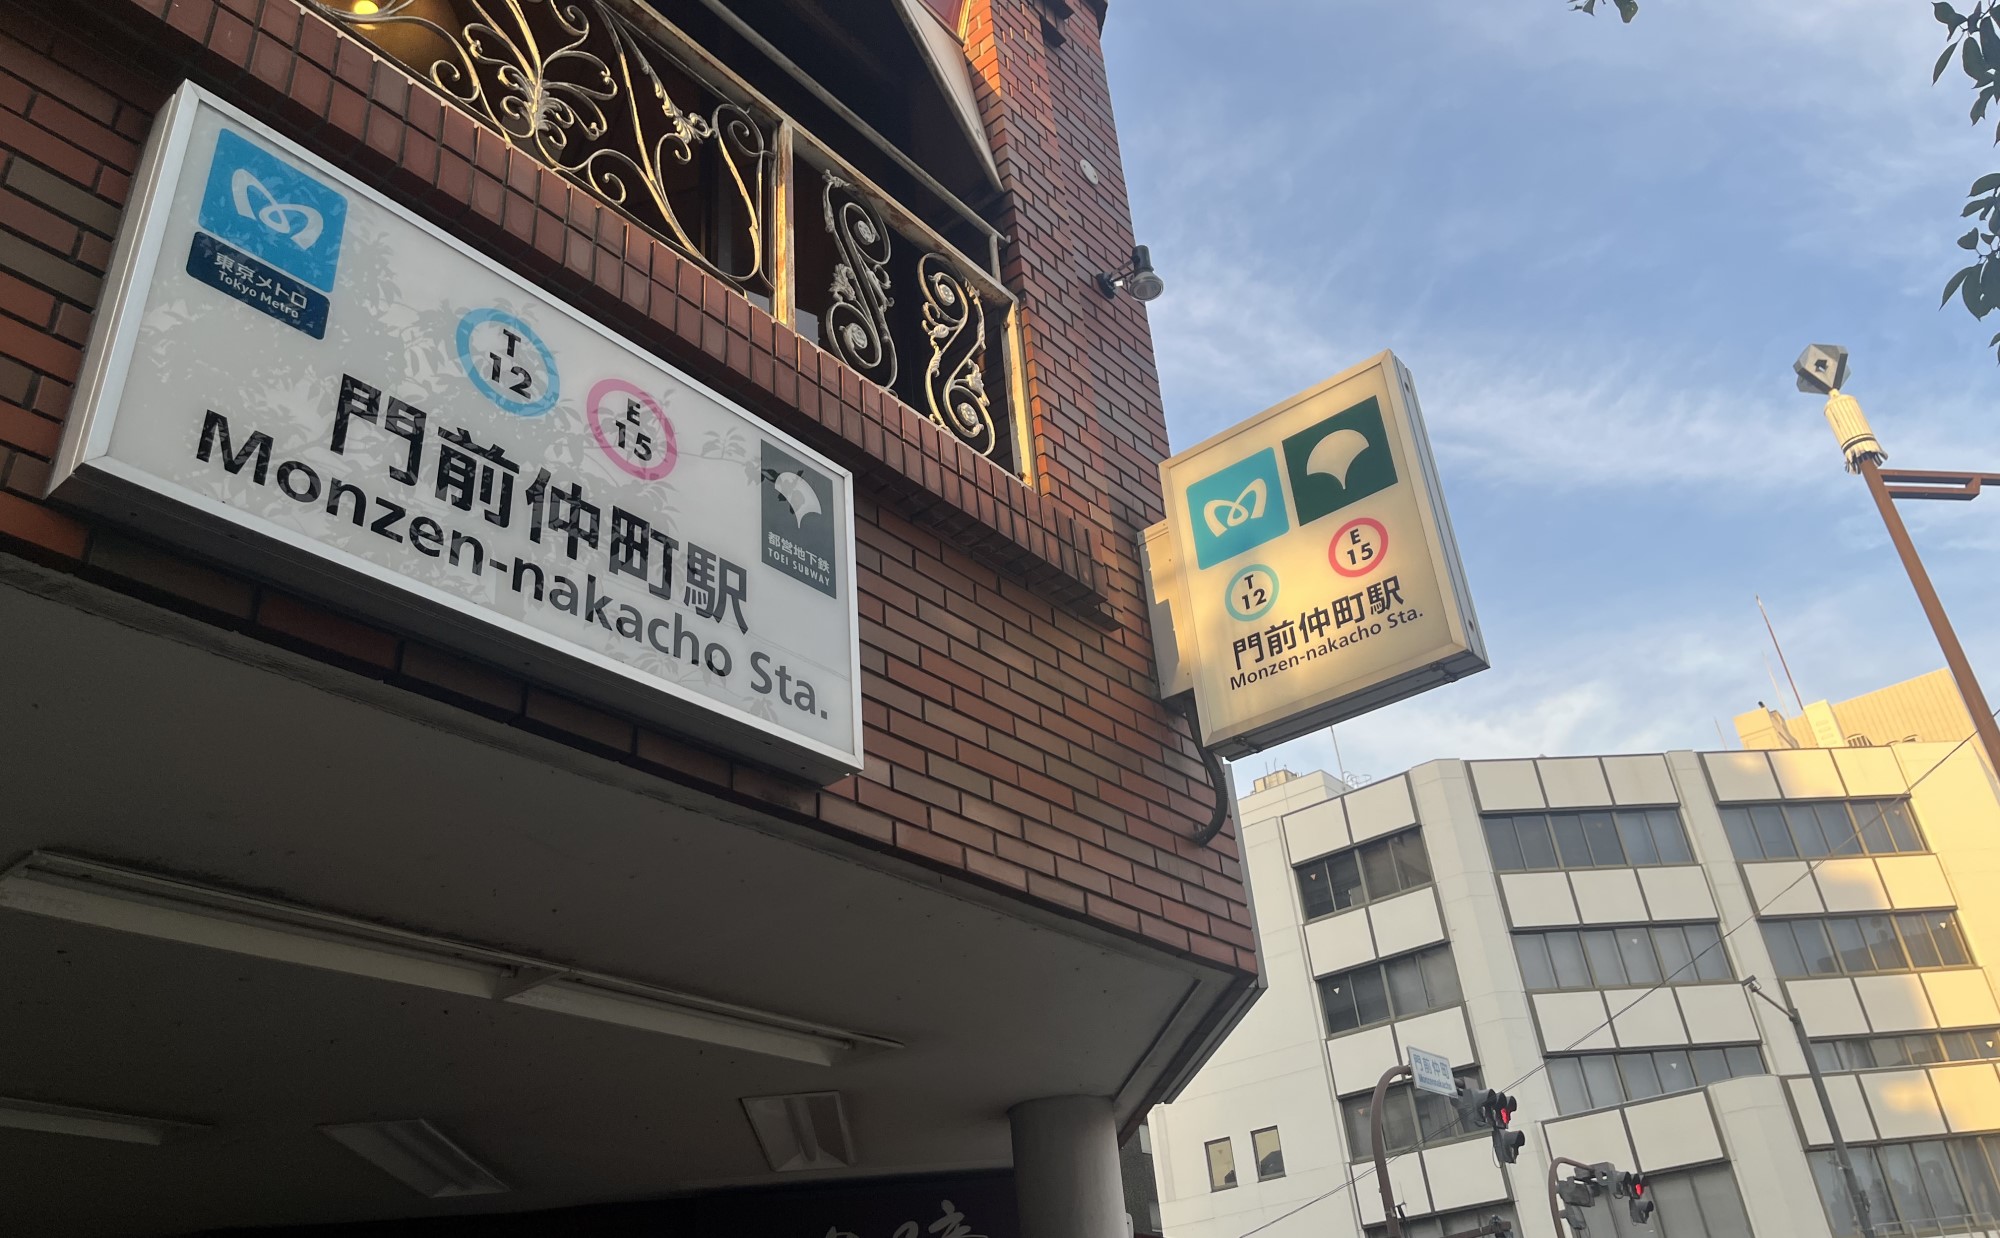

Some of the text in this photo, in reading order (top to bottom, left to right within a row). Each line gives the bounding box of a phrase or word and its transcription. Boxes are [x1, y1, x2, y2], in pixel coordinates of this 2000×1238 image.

[214, 252, 307, 309] 東京メトロ
[219, 270, 299, 318] Tokyo Metro
[503, 328, 521, 358] T
[489, 352, 532, 399] 12
[626, 398, 641, 426] E
[615, 420, 652, 461] 15
[330, 373, 749, 635] 門前仲町駅
[768, 531, 830, 574] 都営地下鉄
[1347, 542, 1374, 565] 15
[1349, 528, 1361, 545] E
[196, 409, 828, 720] Monzen-nakacho Sta.
[768, 547, 830, 586] TOEI SUBWAY
[1244, 574, 1254, 589] T
[1241, 588, 1267, 610] 12
[1232, 575, 1404, 670] 門前仲町駅
[1230, 607, 1424, 690] Monzen-nakacho Sta.
